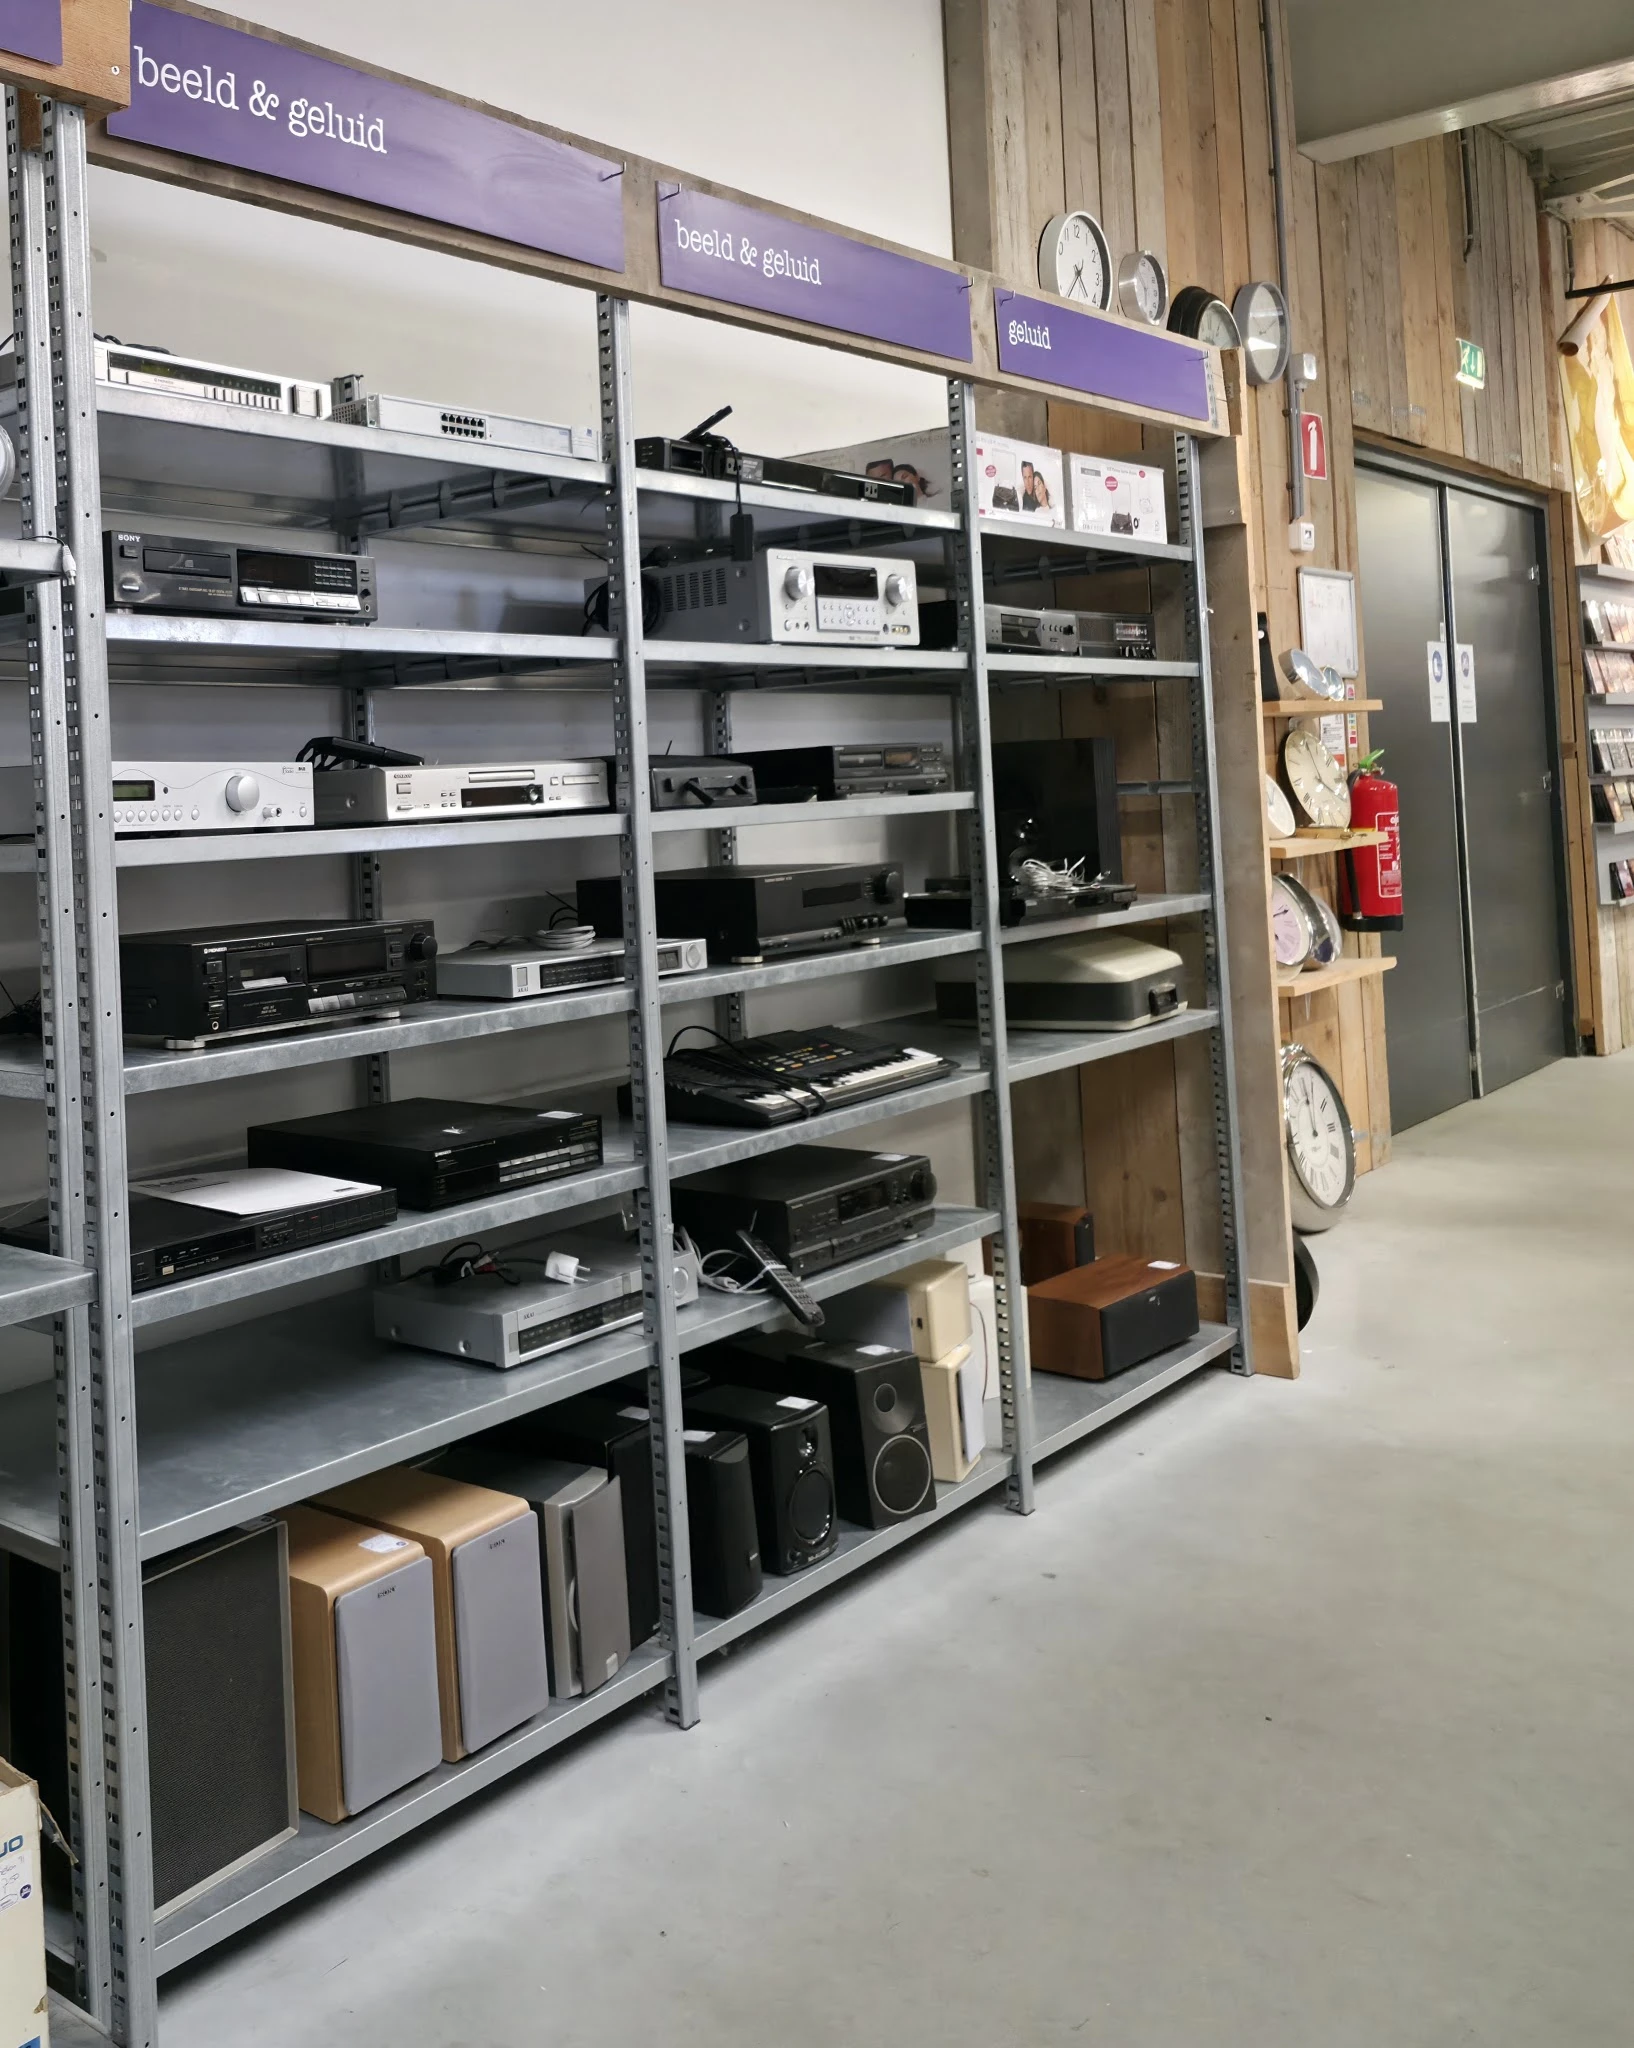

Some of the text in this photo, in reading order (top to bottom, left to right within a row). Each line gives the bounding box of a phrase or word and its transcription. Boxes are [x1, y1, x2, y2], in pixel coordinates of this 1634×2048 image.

[134, 45, 388, 153] beeld & geluid
[1073, 224, 1080, 239] 12
[675, 218, 821, 285] beeld & geluid
[1009, 320, 1051, 350] geluid
[118, 534, 141, 543] SONY
